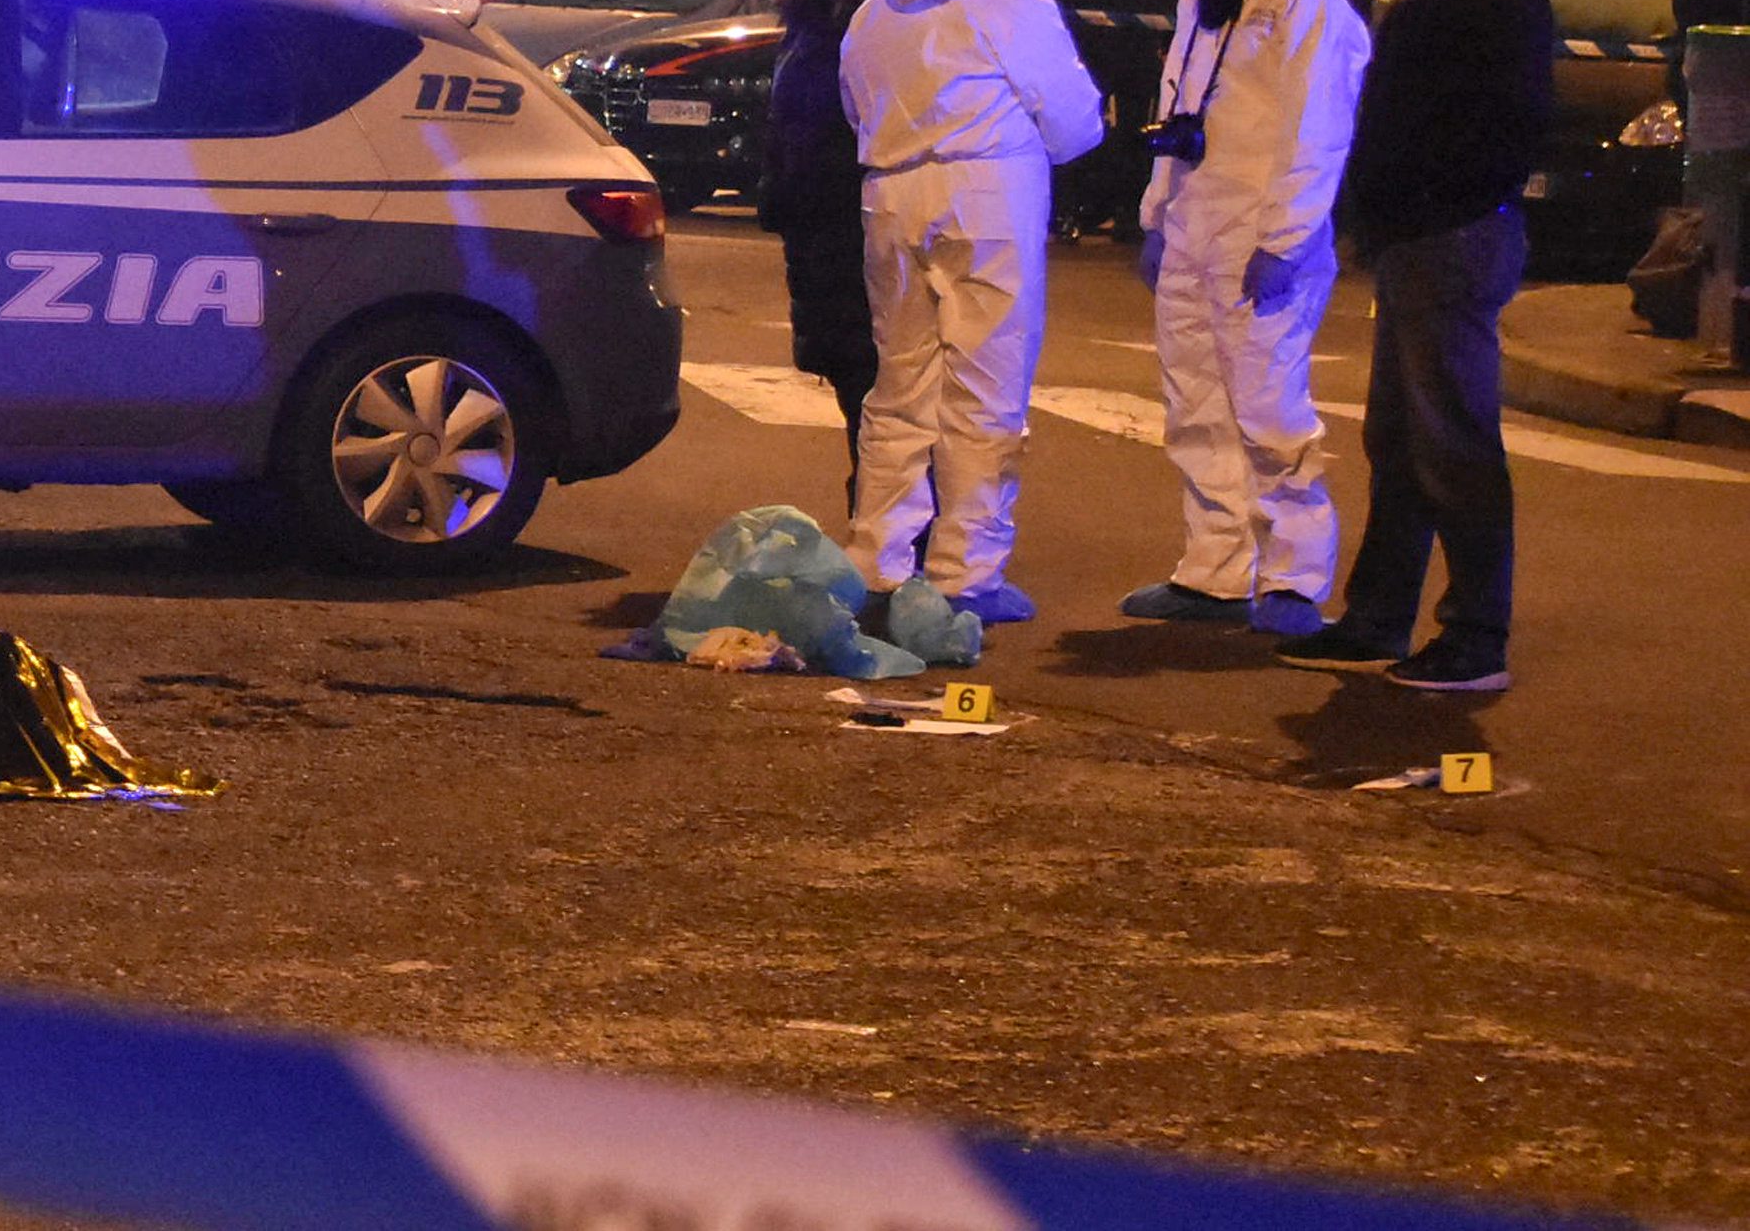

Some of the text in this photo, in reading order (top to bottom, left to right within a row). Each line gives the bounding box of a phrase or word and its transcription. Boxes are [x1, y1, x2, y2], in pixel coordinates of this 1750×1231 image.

[415, 74, 525, 115] 113
[958, 688, 976, 712] 6
[1456, 758, 1475, 783] 7
